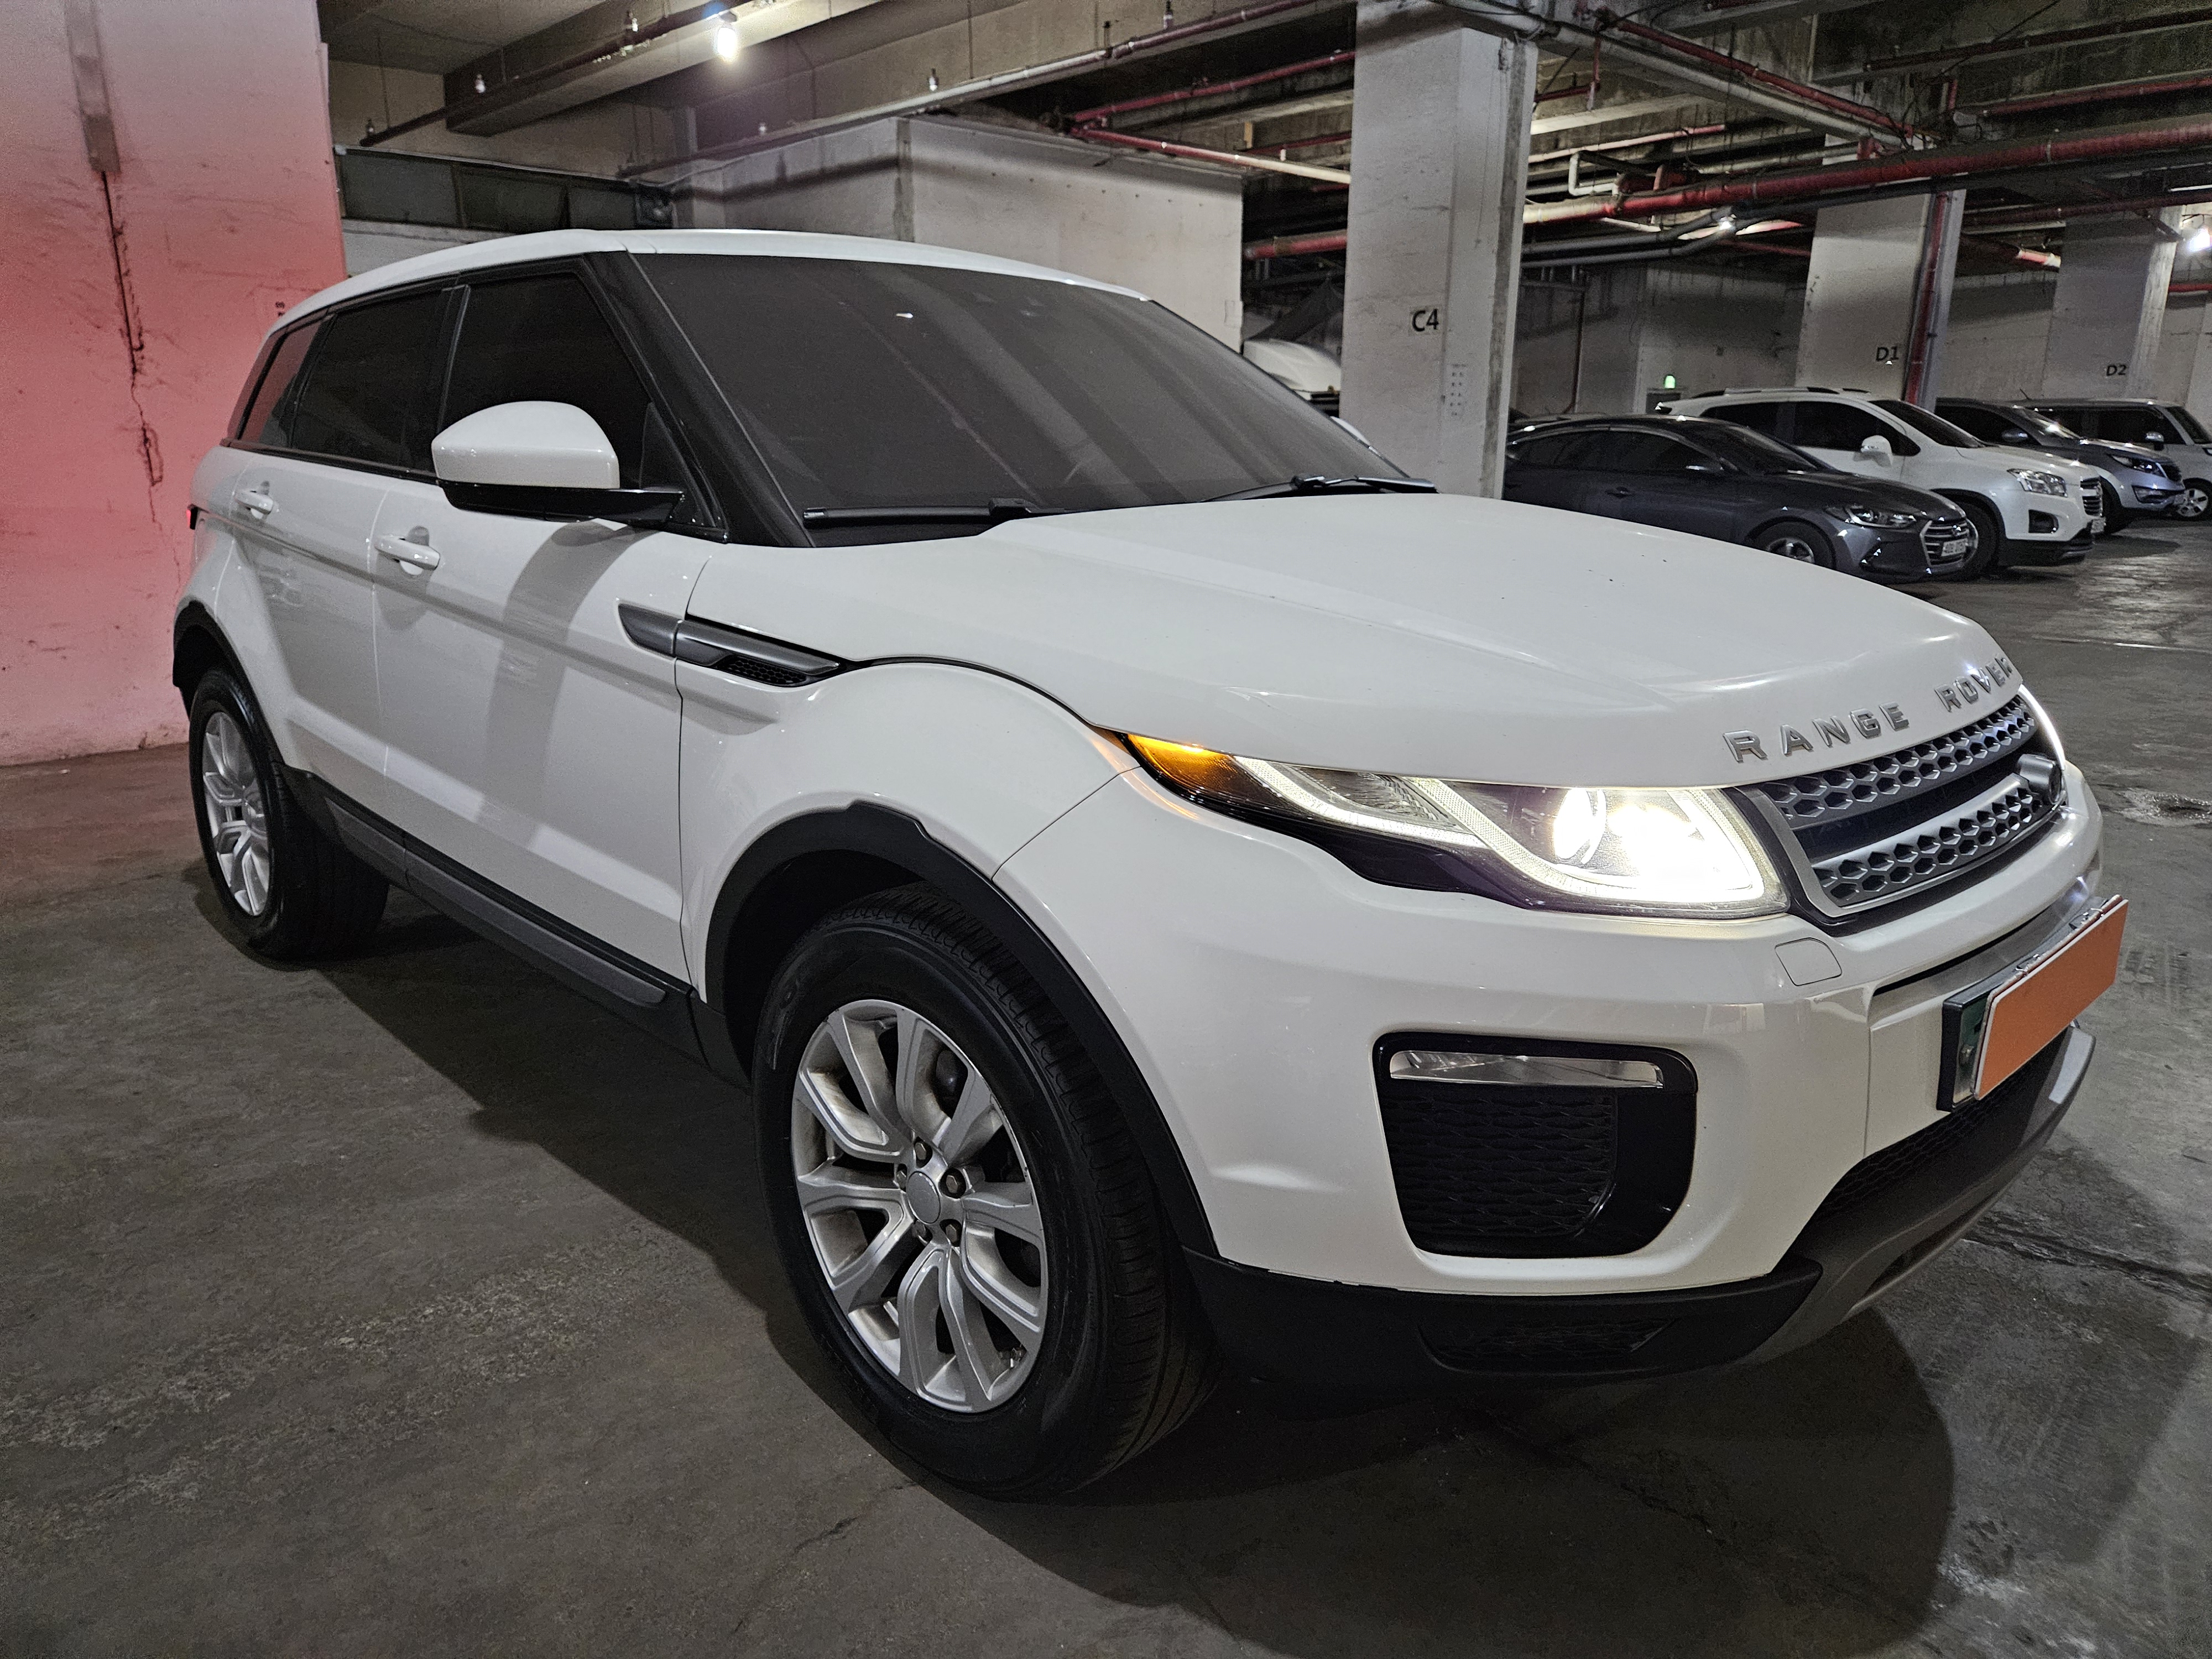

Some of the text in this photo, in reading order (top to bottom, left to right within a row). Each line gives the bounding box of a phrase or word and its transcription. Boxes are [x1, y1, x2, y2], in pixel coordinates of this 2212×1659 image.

[1412, 308, 1439, 332] C4
[1876, 346, 1899, 361] D1
[2106, 364, 2127, 376] D2
[1722, 701, 1910, 764] RANGE
